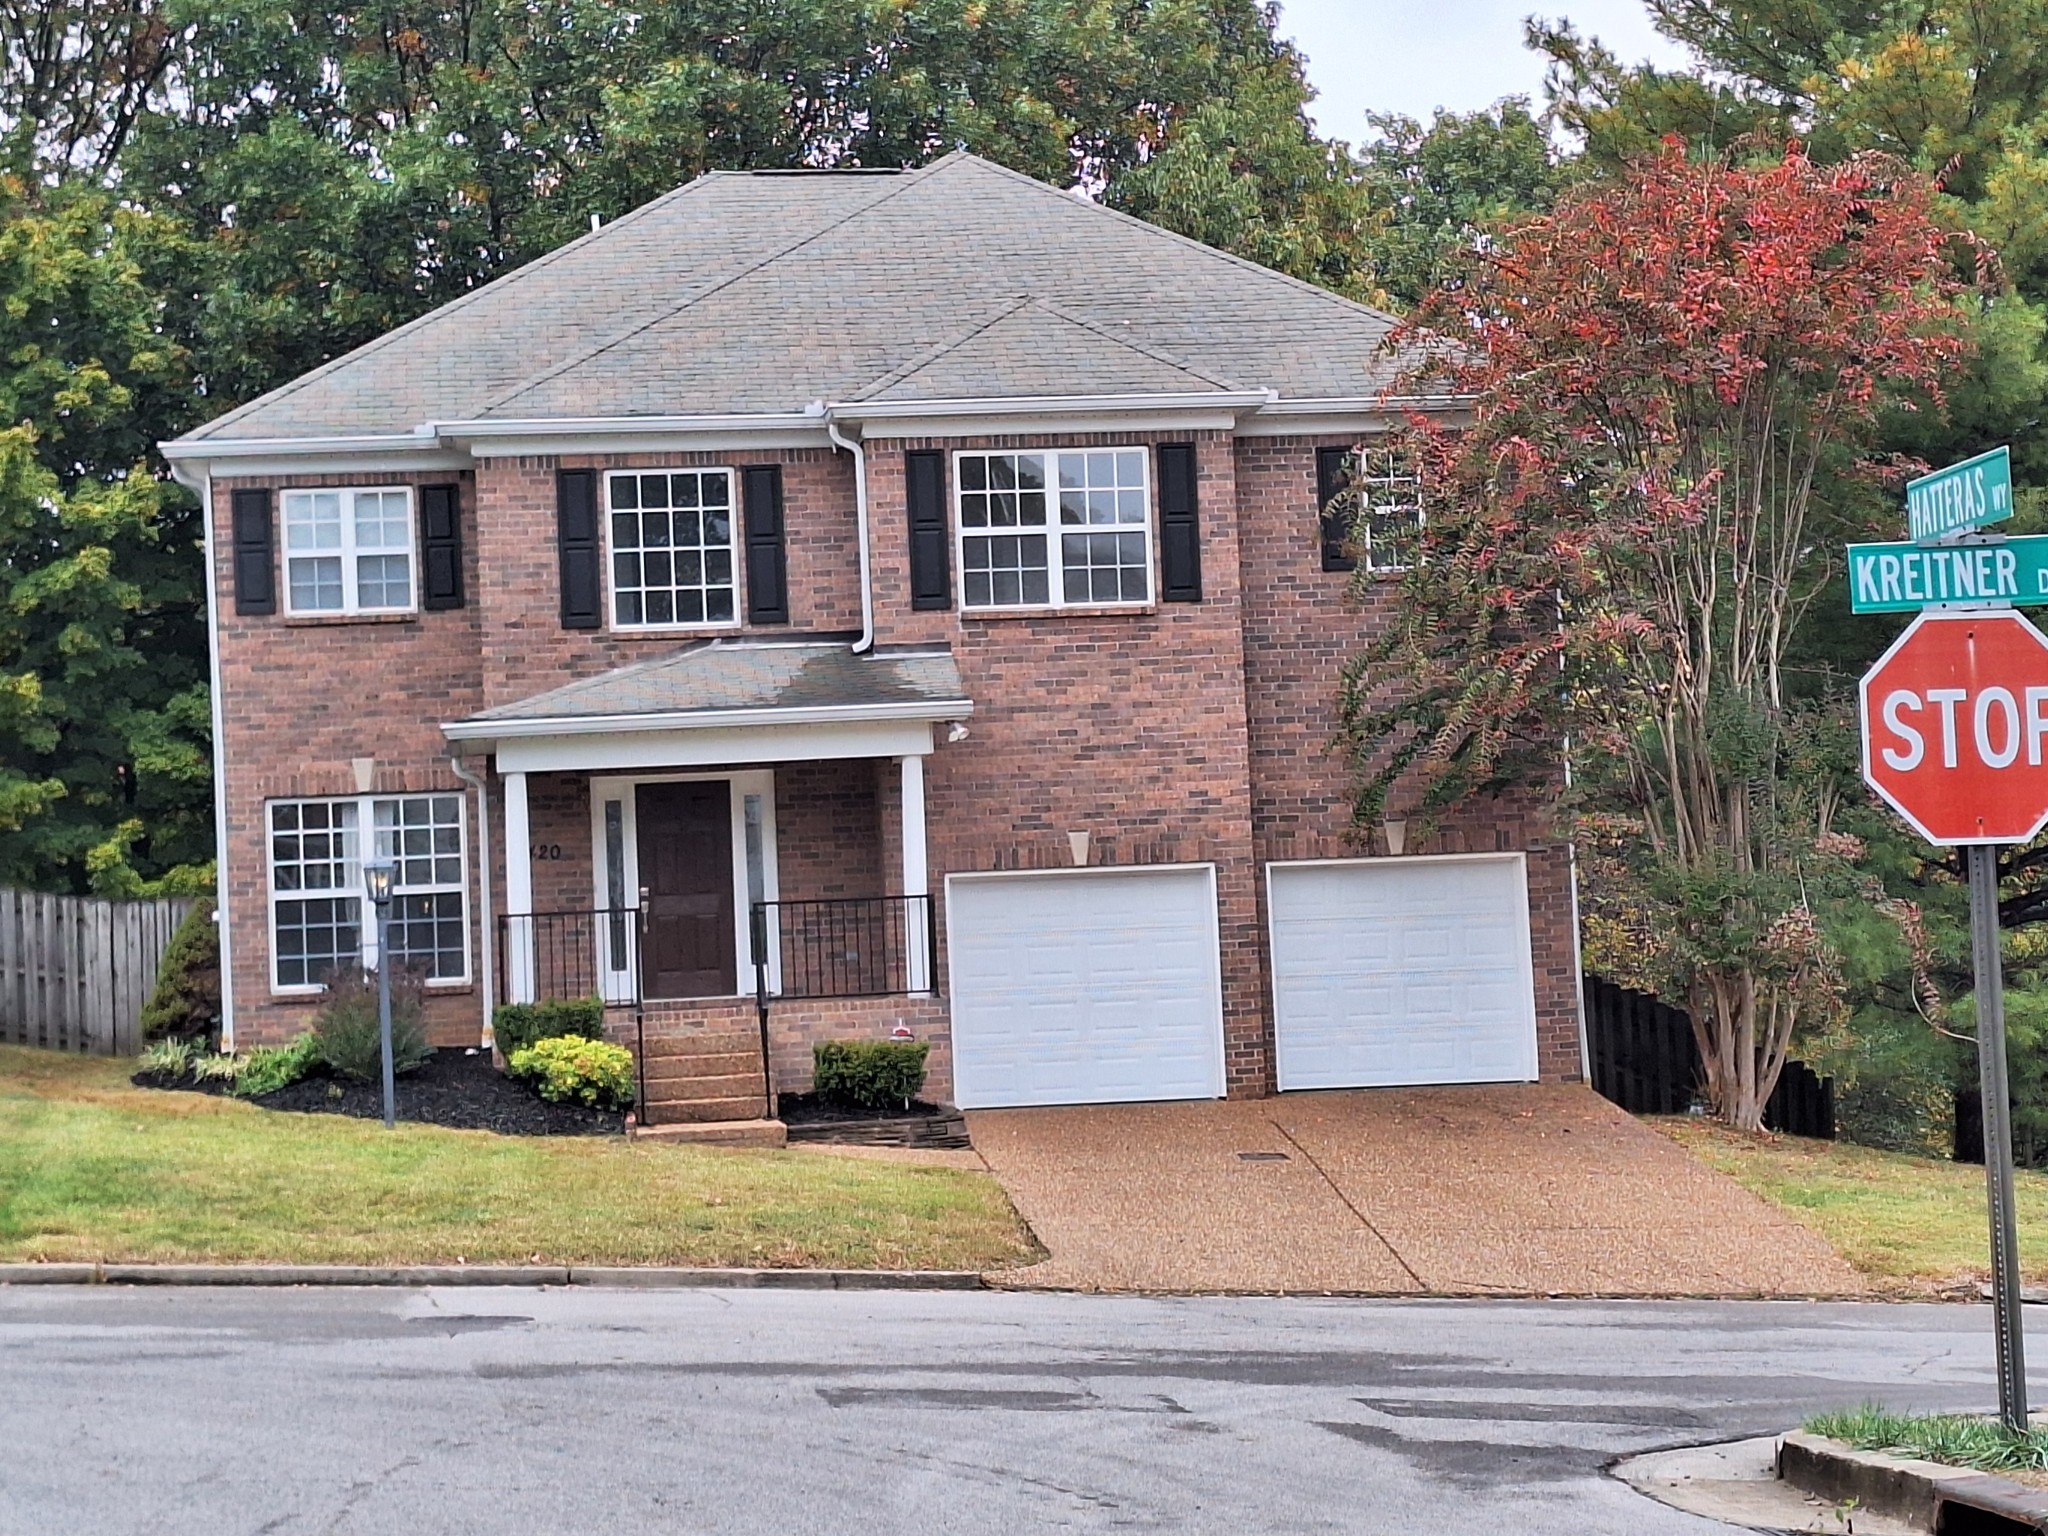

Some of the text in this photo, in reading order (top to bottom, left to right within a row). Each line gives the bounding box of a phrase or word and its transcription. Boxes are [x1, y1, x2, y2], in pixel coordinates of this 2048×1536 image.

[1911, 466, 2007, 540] HATTERAS WY
[1856, 549, 2018, 603] KREITNER
